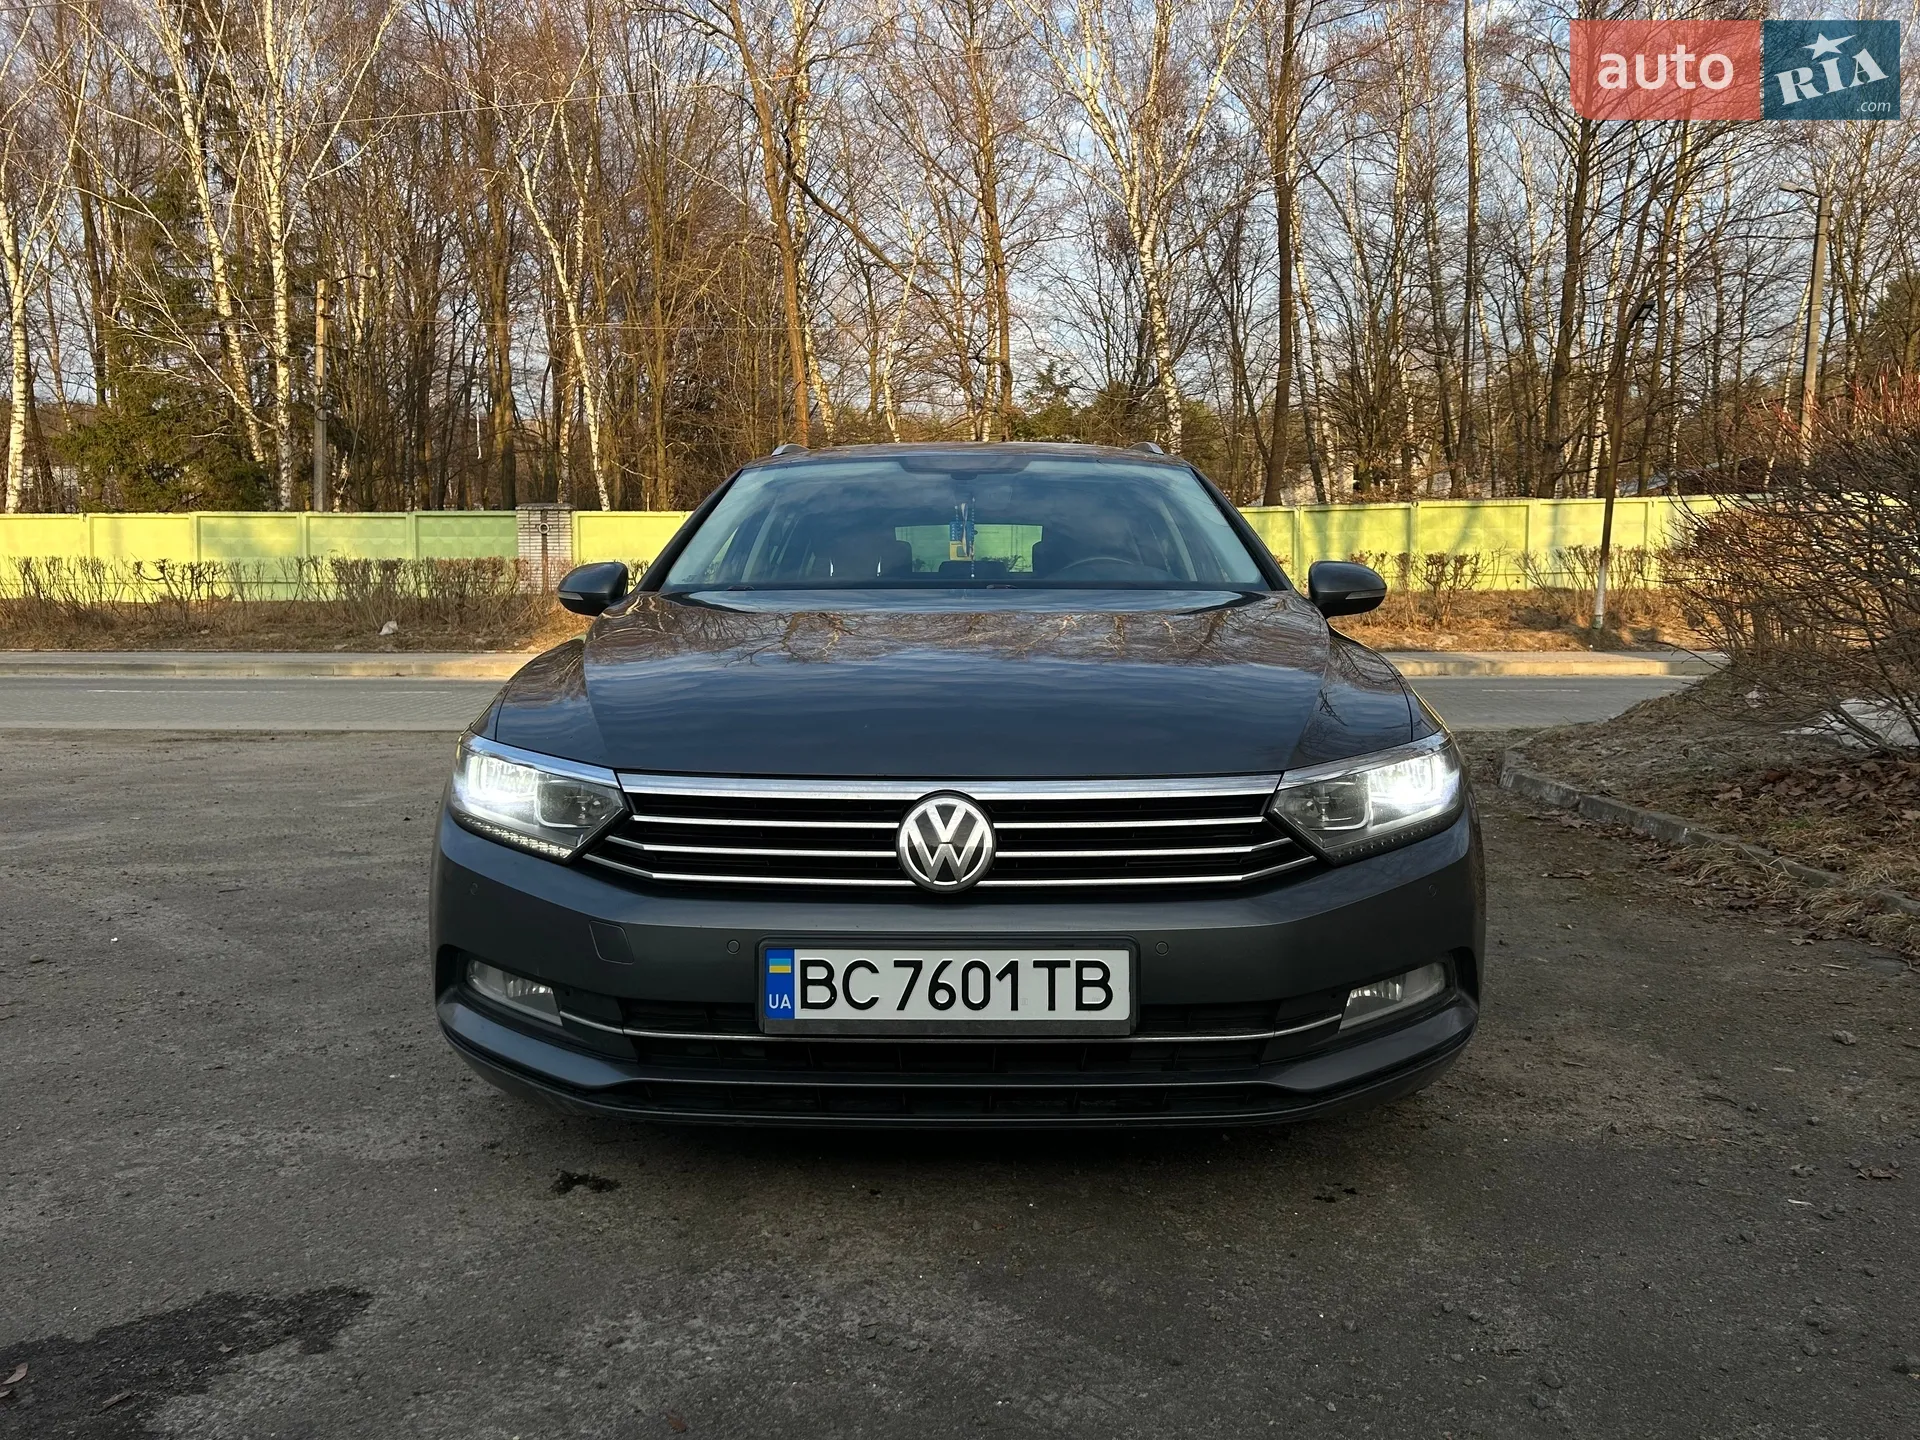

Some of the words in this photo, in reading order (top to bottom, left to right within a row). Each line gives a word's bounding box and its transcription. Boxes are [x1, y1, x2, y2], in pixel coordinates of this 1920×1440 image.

[769, 993, 792, 1009] UA
[800, 958, 880, 1011] BC
[893, 958, 1019, 1011] 7601
[1032, 959, 1113, 1011] TB
